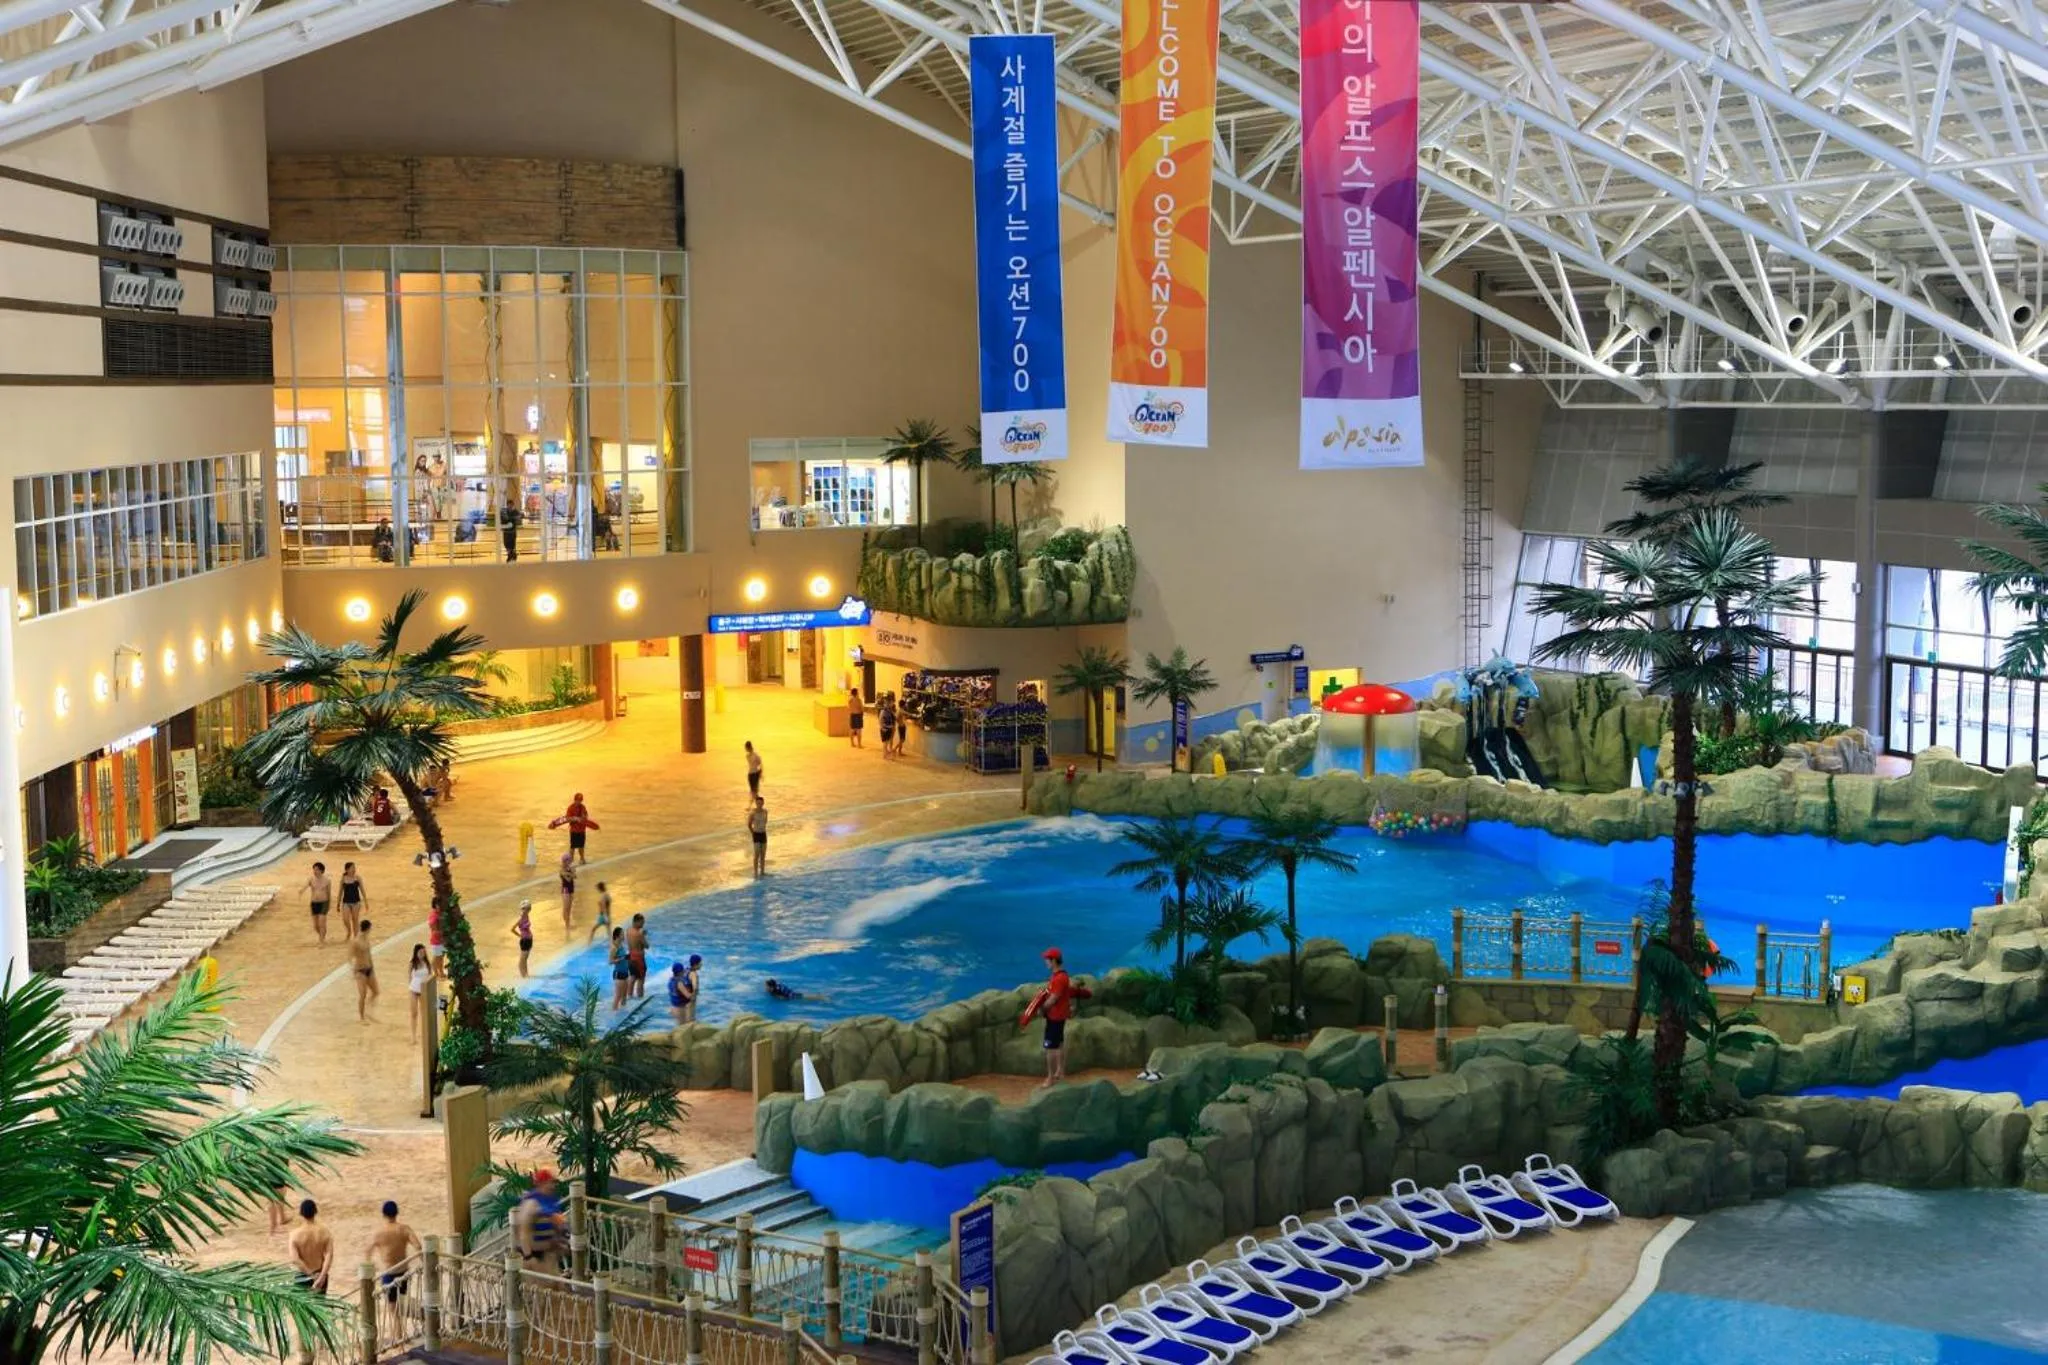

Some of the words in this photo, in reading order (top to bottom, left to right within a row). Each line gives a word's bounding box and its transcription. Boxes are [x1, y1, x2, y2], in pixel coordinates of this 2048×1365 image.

[1000, 54, 1026, 145] 사계절
[1340, 74, 1377, 189] 알프스
[1003, 152, 1030, 243] 즐기는
[1155, 135, 1177, 179] TO
[1006, 255, 1031, 393] 오션700
[1150, 193, 1175, 369] OCEAN700
[1343, 206, 1377, 374] 알펜시아
[1135, 403, 1176, 422] OCEAN
